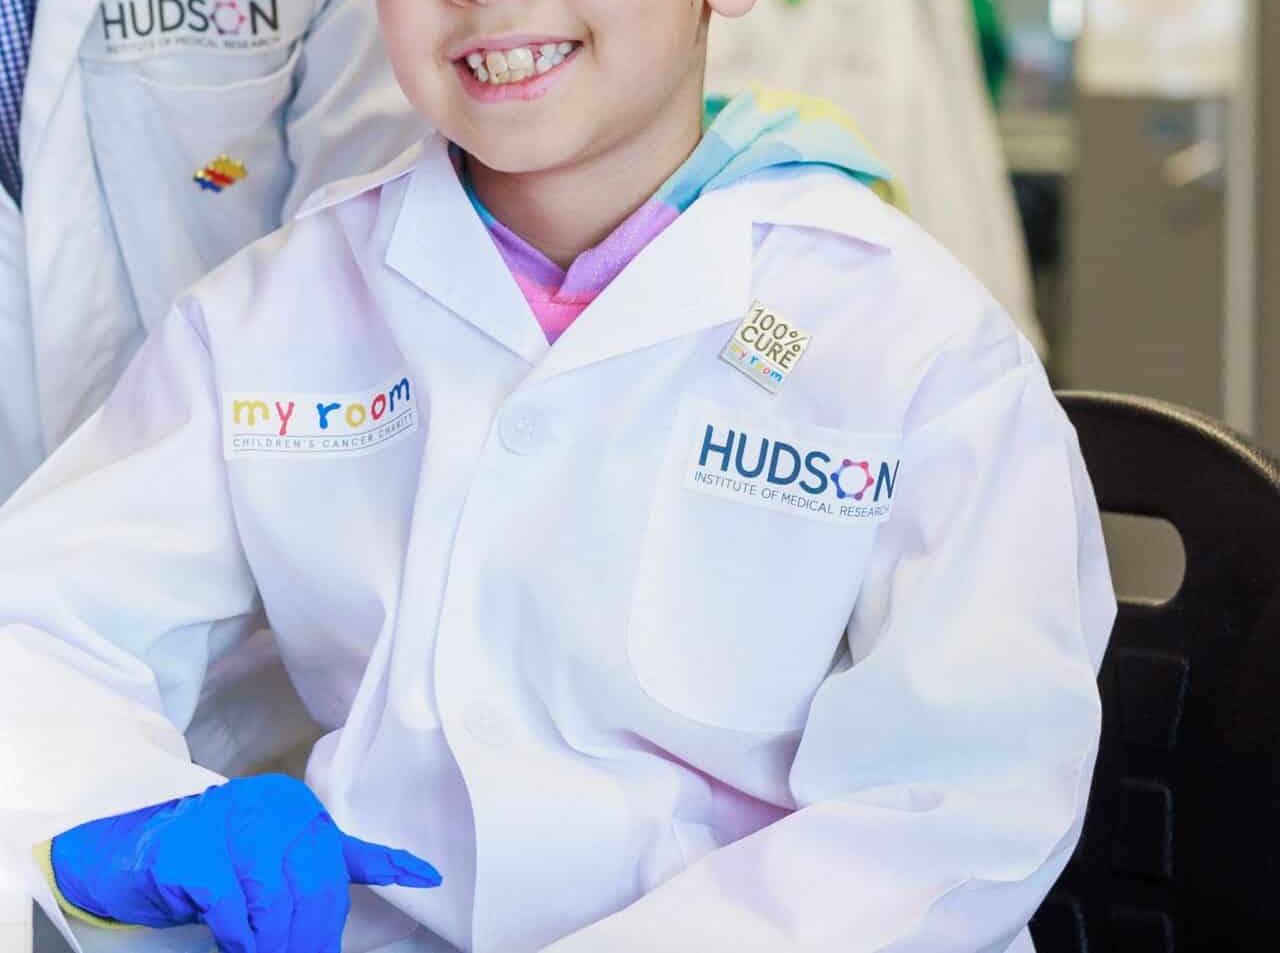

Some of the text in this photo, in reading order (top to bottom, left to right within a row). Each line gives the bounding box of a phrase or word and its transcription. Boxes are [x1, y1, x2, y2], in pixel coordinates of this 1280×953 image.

[740, 325, 797, 369] CURE
[752, 309, 808, 352] 100%
[232, 377, 411, 436] my room
[232, 412, 414, 449] CHILDREN'S CANCER CHARITY
[698, 424, 900, 502] HUDSON
[694, 471, 889, 519] INSTITUTE OF MEDICAL RESEARC
